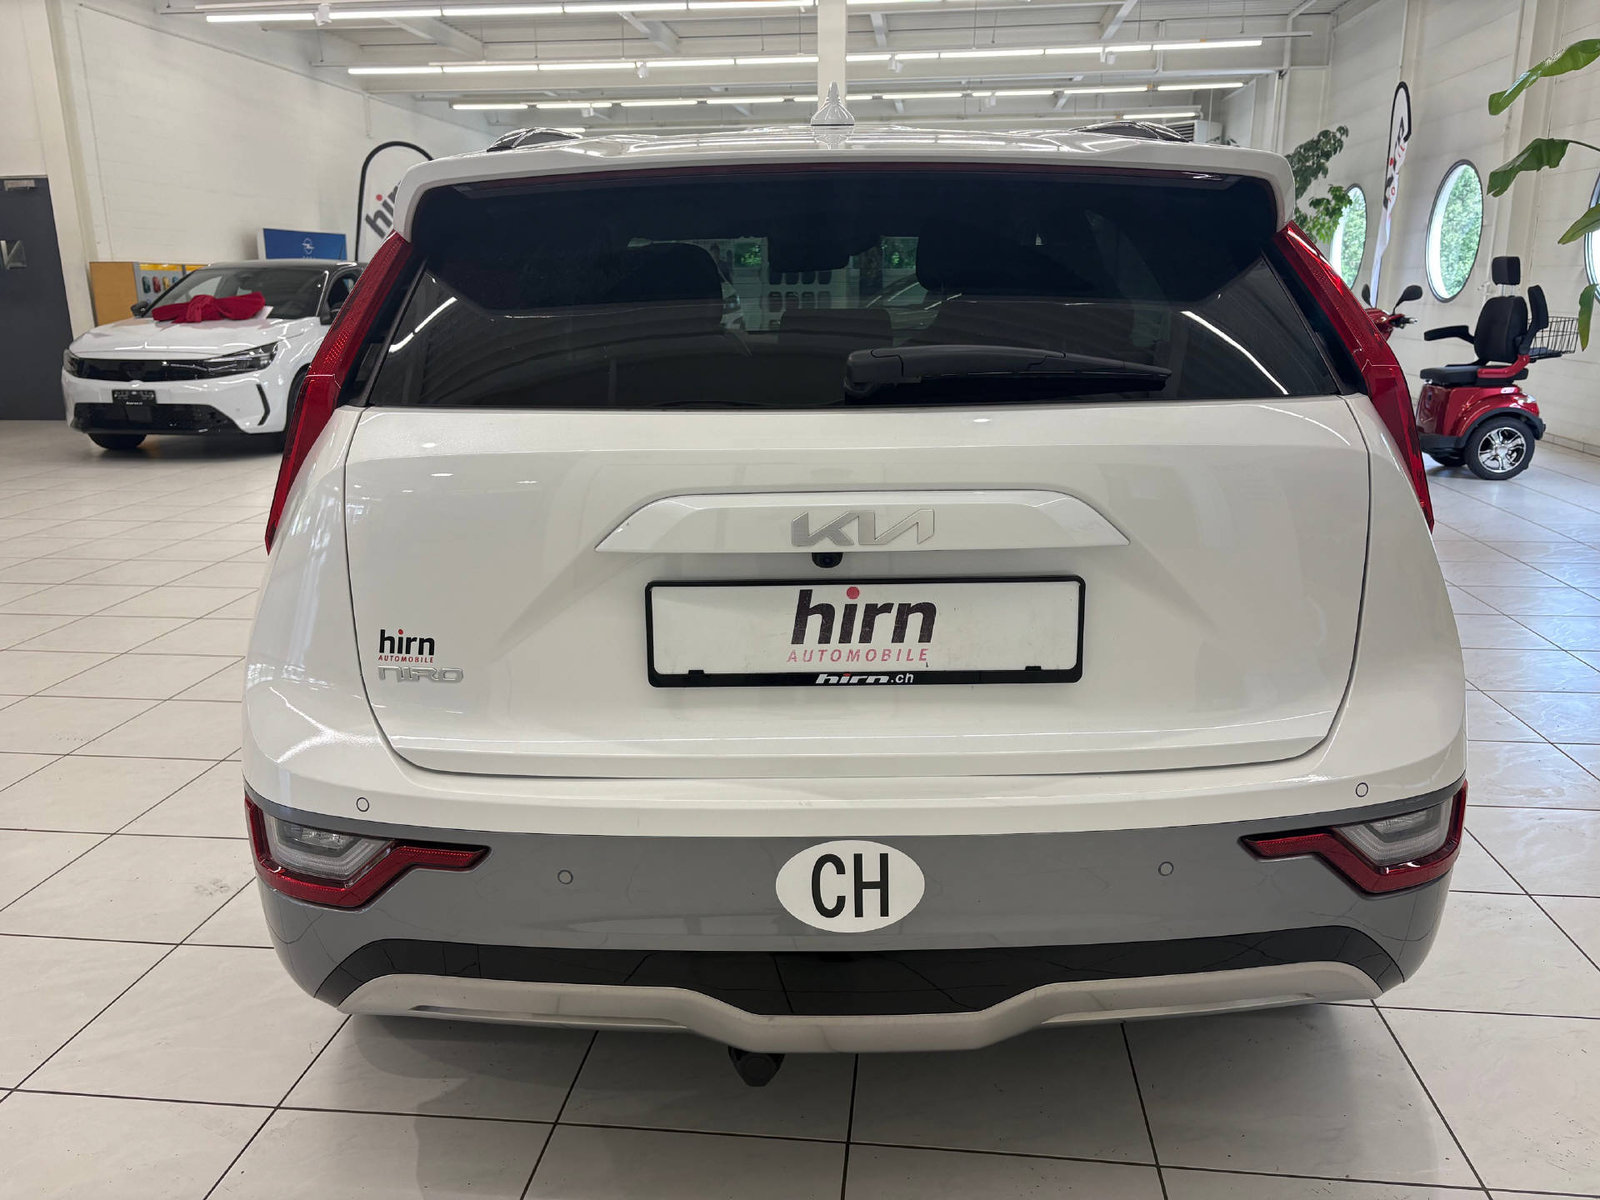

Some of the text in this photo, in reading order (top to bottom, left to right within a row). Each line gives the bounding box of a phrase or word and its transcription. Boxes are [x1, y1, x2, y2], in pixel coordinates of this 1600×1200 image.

[791, 509, 935, 547] KIA
[791, 586, 937, 644] hirn
[379, 629, 435, 655] hirn
[378, 655, 434, 663] AUTOMOBILE
[787, 648, 929, 662] AUTOMOBILE
[377, 666, 464, 683] NIRO
[816, 672, 914, 685] hirn.ch
[811, 853, 889, 919] CH
